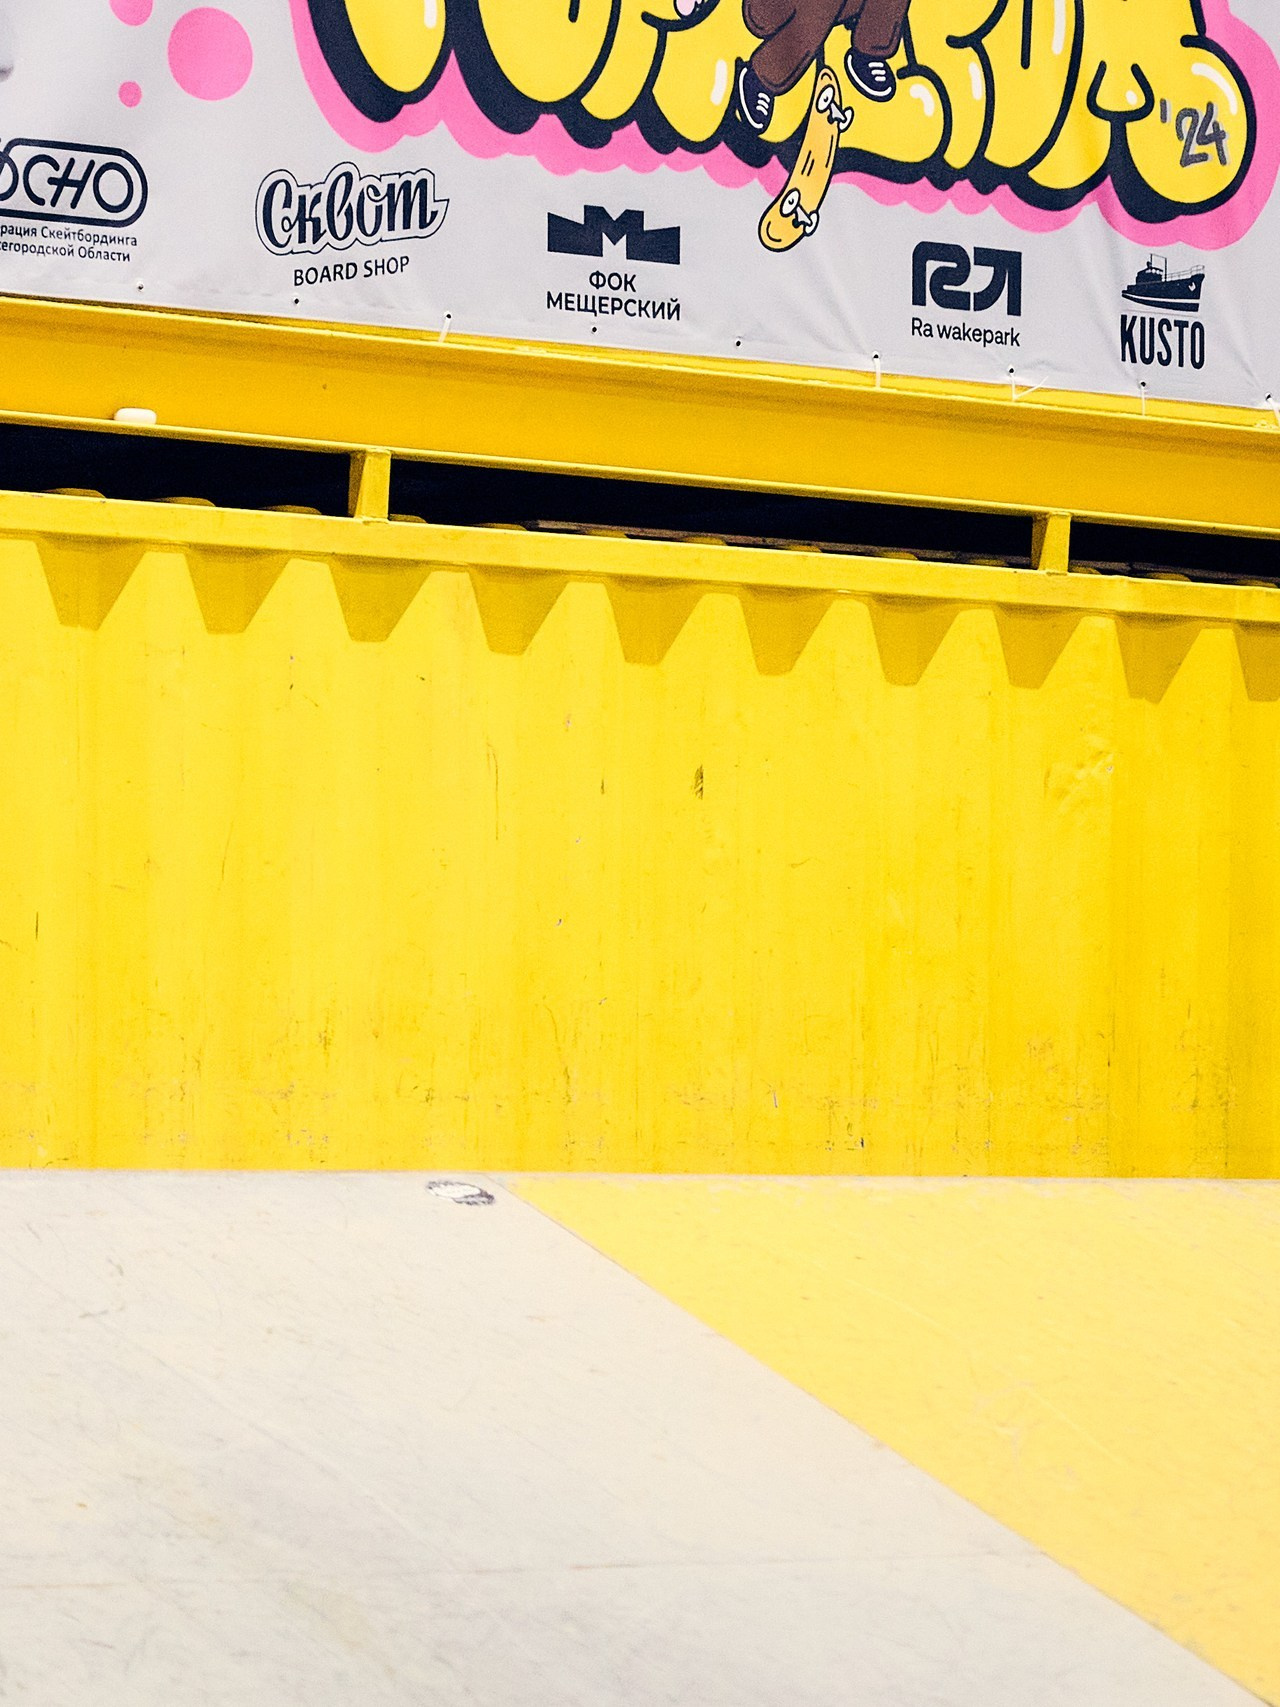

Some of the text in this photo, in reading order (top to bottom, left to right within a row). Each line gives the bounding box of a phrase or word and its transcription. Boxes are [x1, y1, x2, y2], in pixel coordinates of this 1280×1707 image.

[41, 226, 138, 247] Скейтбординга
[78, 246, 131, 262] Области
[293, 255, 410, 287] BOARD SHOP
[589, 270, 637, 293] ФОК
[546, 290, 681, 321] МЕЩЕРСКИЙ
[911, 317, 1020, 348] Ra wakepark
[1120, 314, 1205, 369] KUSTO
